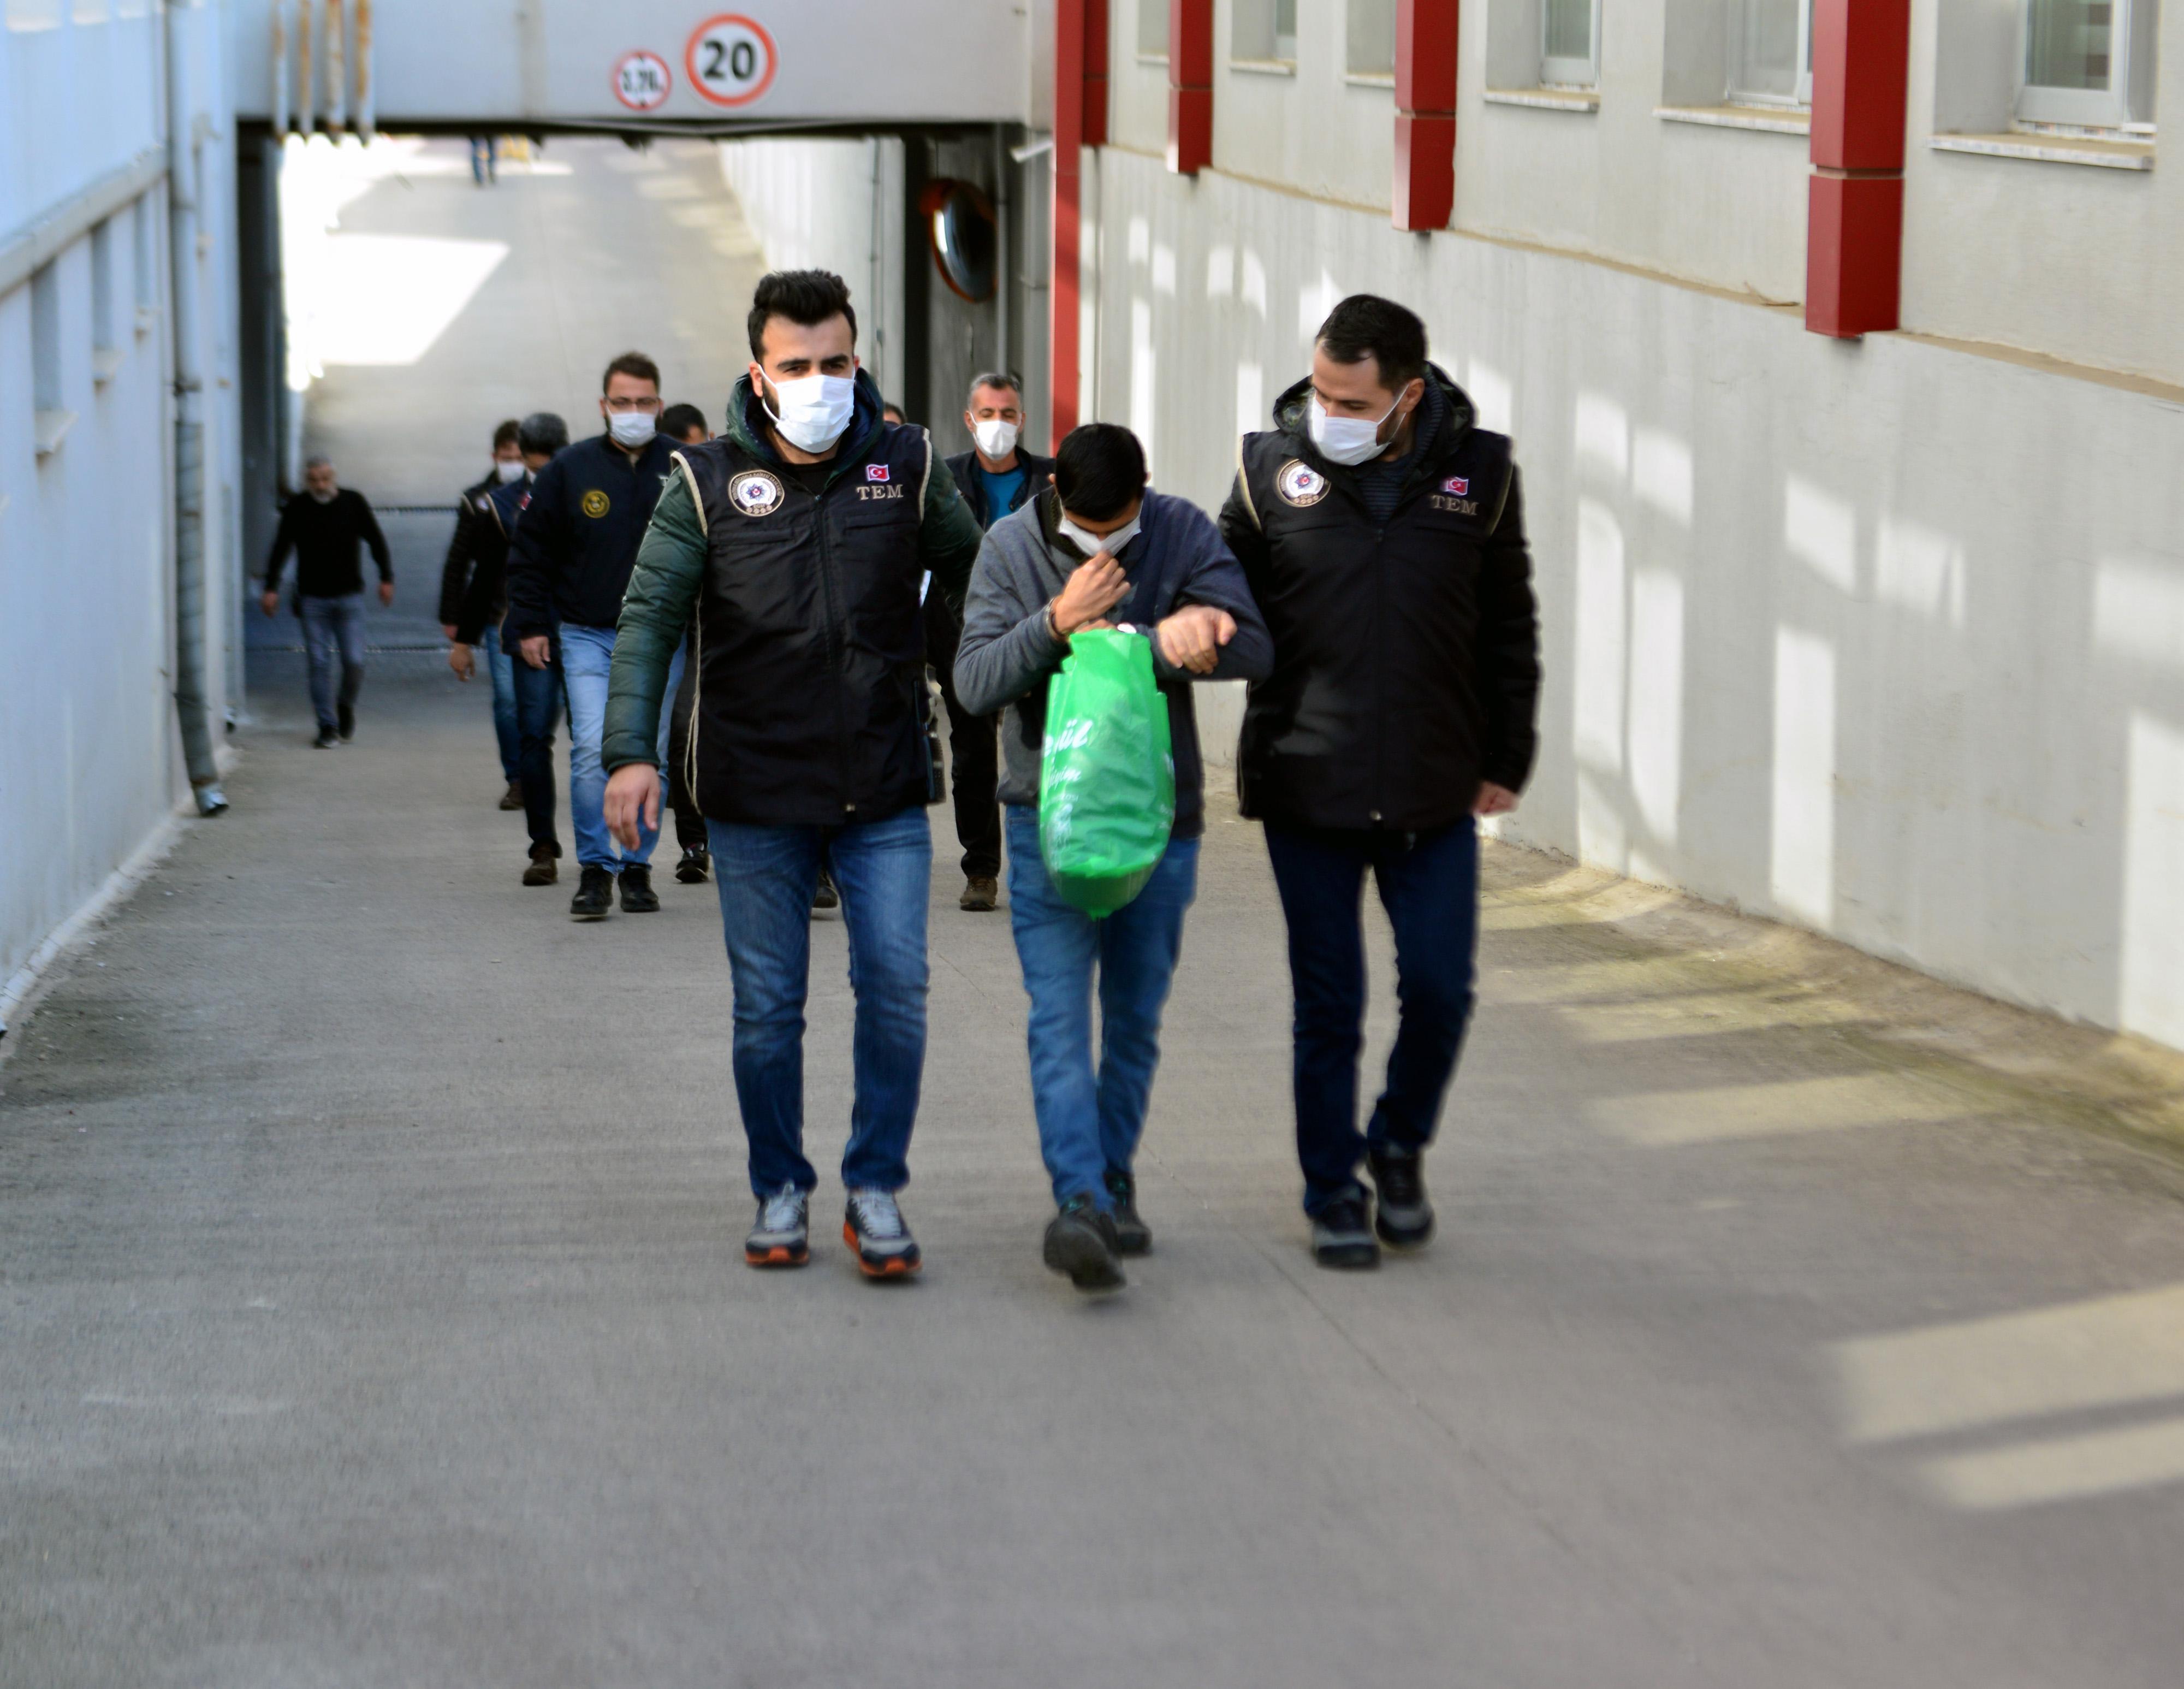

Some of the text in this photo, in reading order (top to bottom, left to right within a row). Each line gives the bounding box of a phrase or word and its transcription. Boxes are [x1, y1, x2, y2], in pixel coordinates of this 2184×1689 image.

[703, 39, 757, 80] 20
[856, 483, 904, 501] TEM
[1431, 494, 1480, 516] TEM
